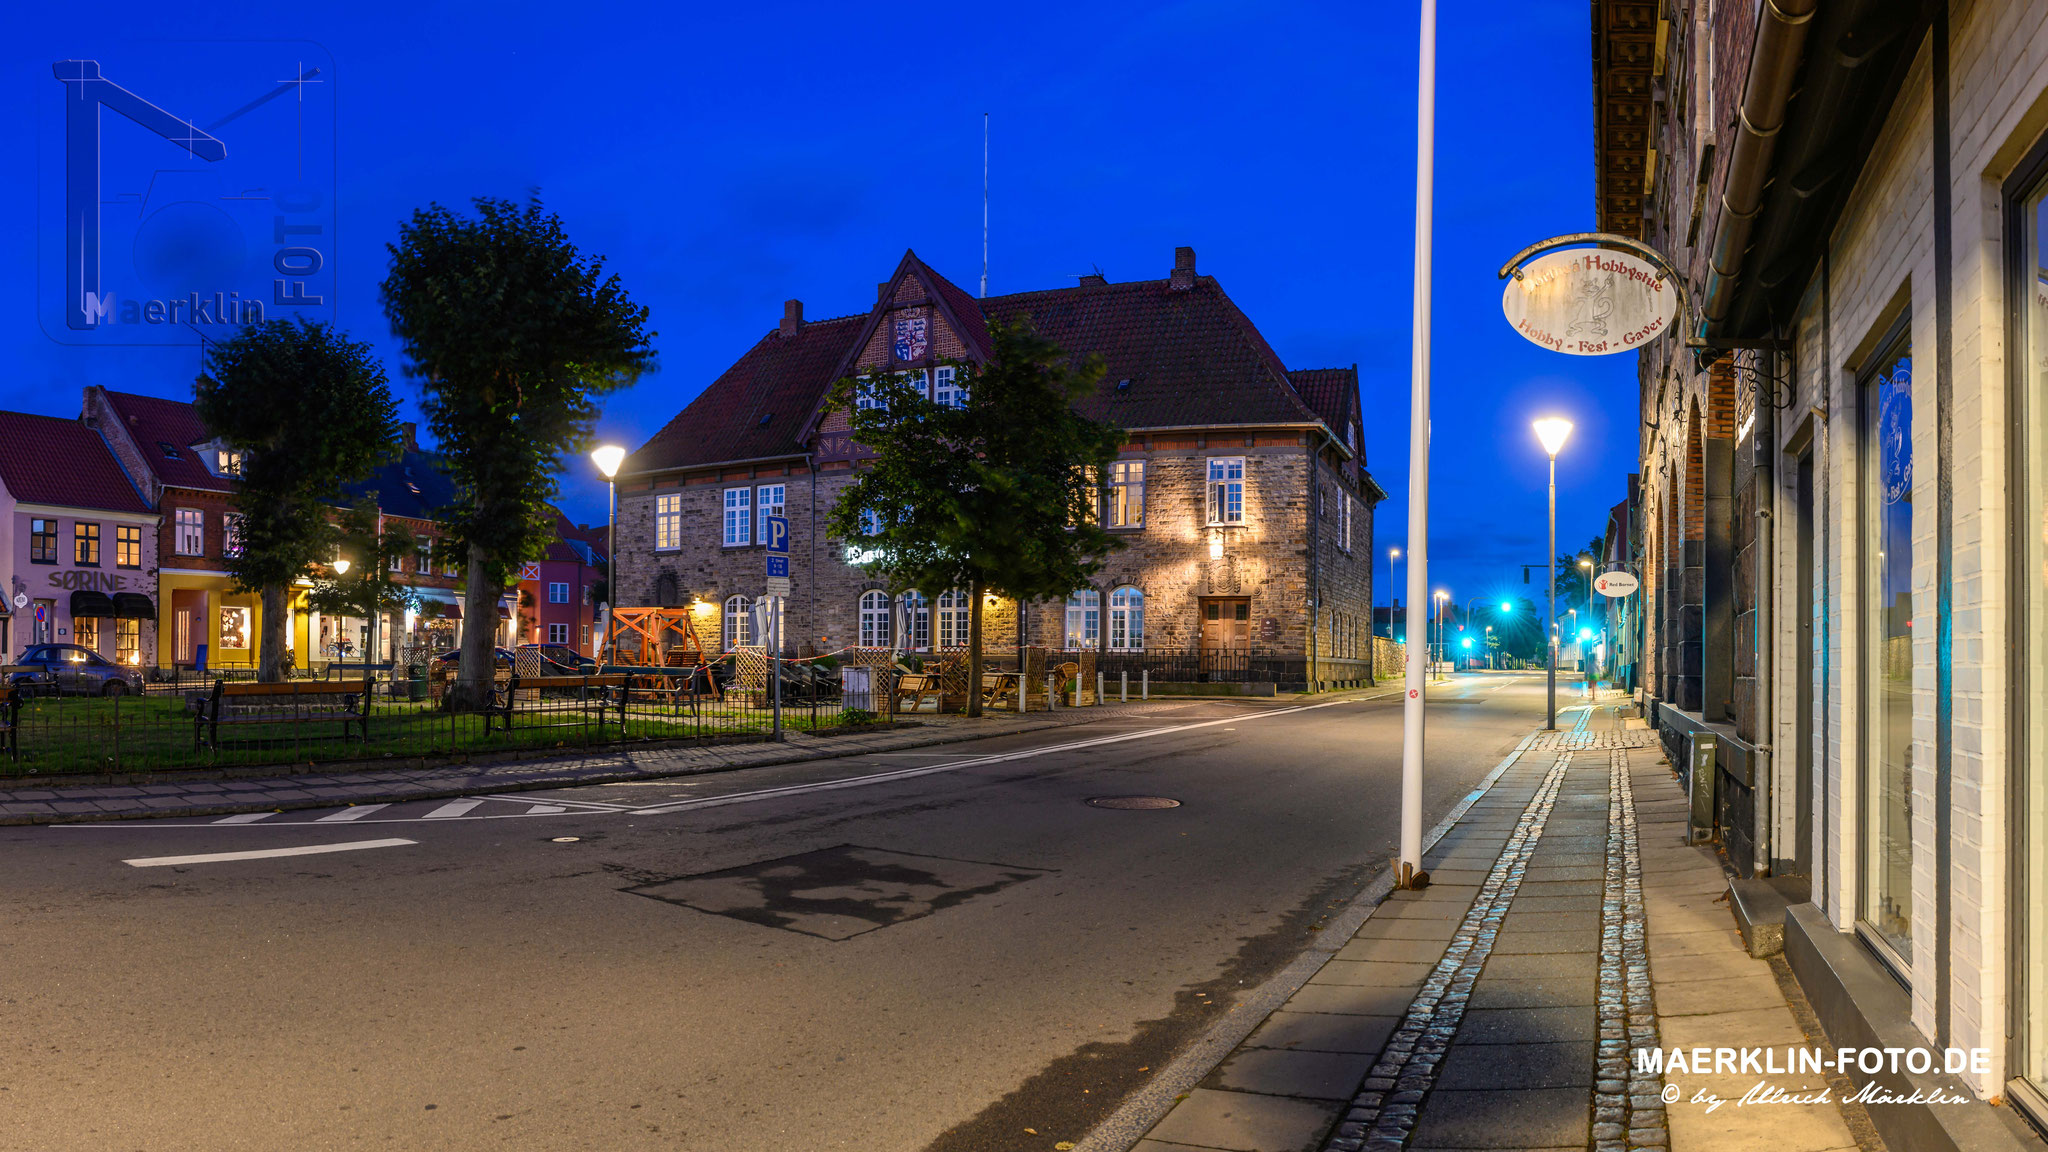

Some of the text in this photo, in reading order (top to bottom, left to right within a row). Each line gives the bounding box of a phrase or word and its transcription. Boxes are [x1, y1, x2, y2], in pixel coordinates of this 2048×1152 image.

[1584, 255, 1662, 292] Hobbystue
[1518, 319, 1563, 351] Hobby
[1578, 341, 1608, 352] Fest
[1623, 316, 1662, 345] Gaver
[770, 520, 786, 549] P
[48, 570, 128, 592] SØRINE
